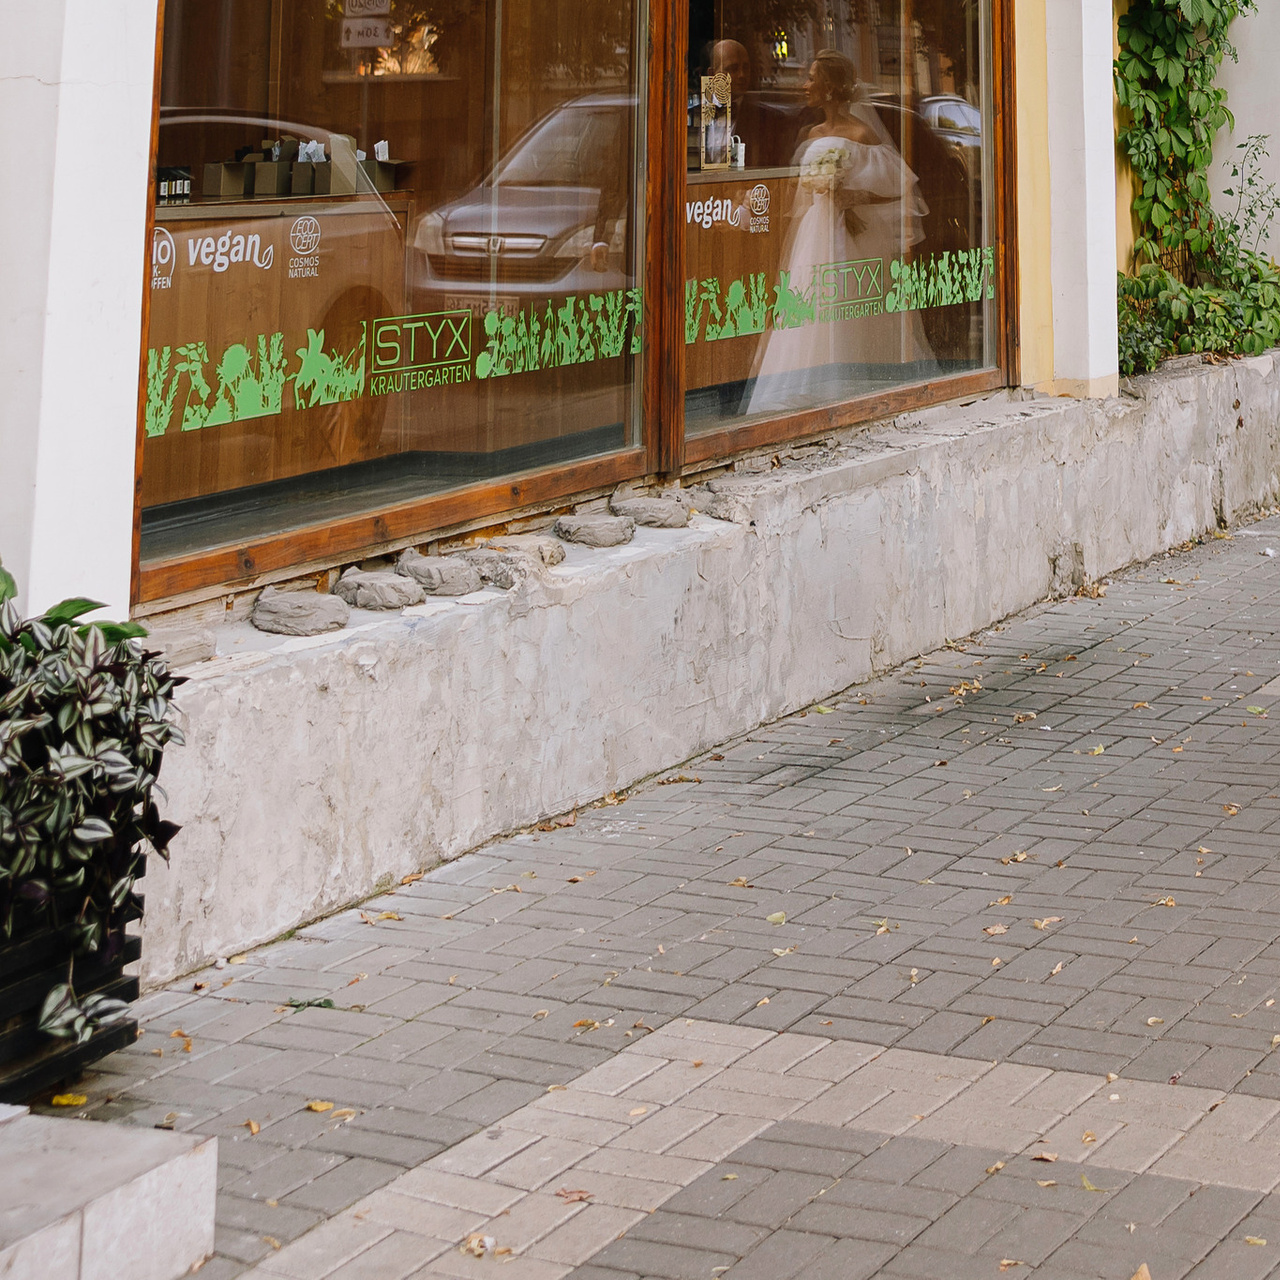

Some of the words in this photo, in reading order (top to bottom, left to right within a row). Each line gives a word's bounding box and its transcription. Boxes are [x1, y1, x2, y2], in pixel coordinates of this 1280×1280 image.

[686, 195, 739, 229] vegan
[188, 229, 273, 273] vegan
[288, 255, 320, 268] COSMOS
[288, 267, 319, 279] NATURAL
[822, 263, 881, 301] STYX
[376, 316, 469, 366] STYX
